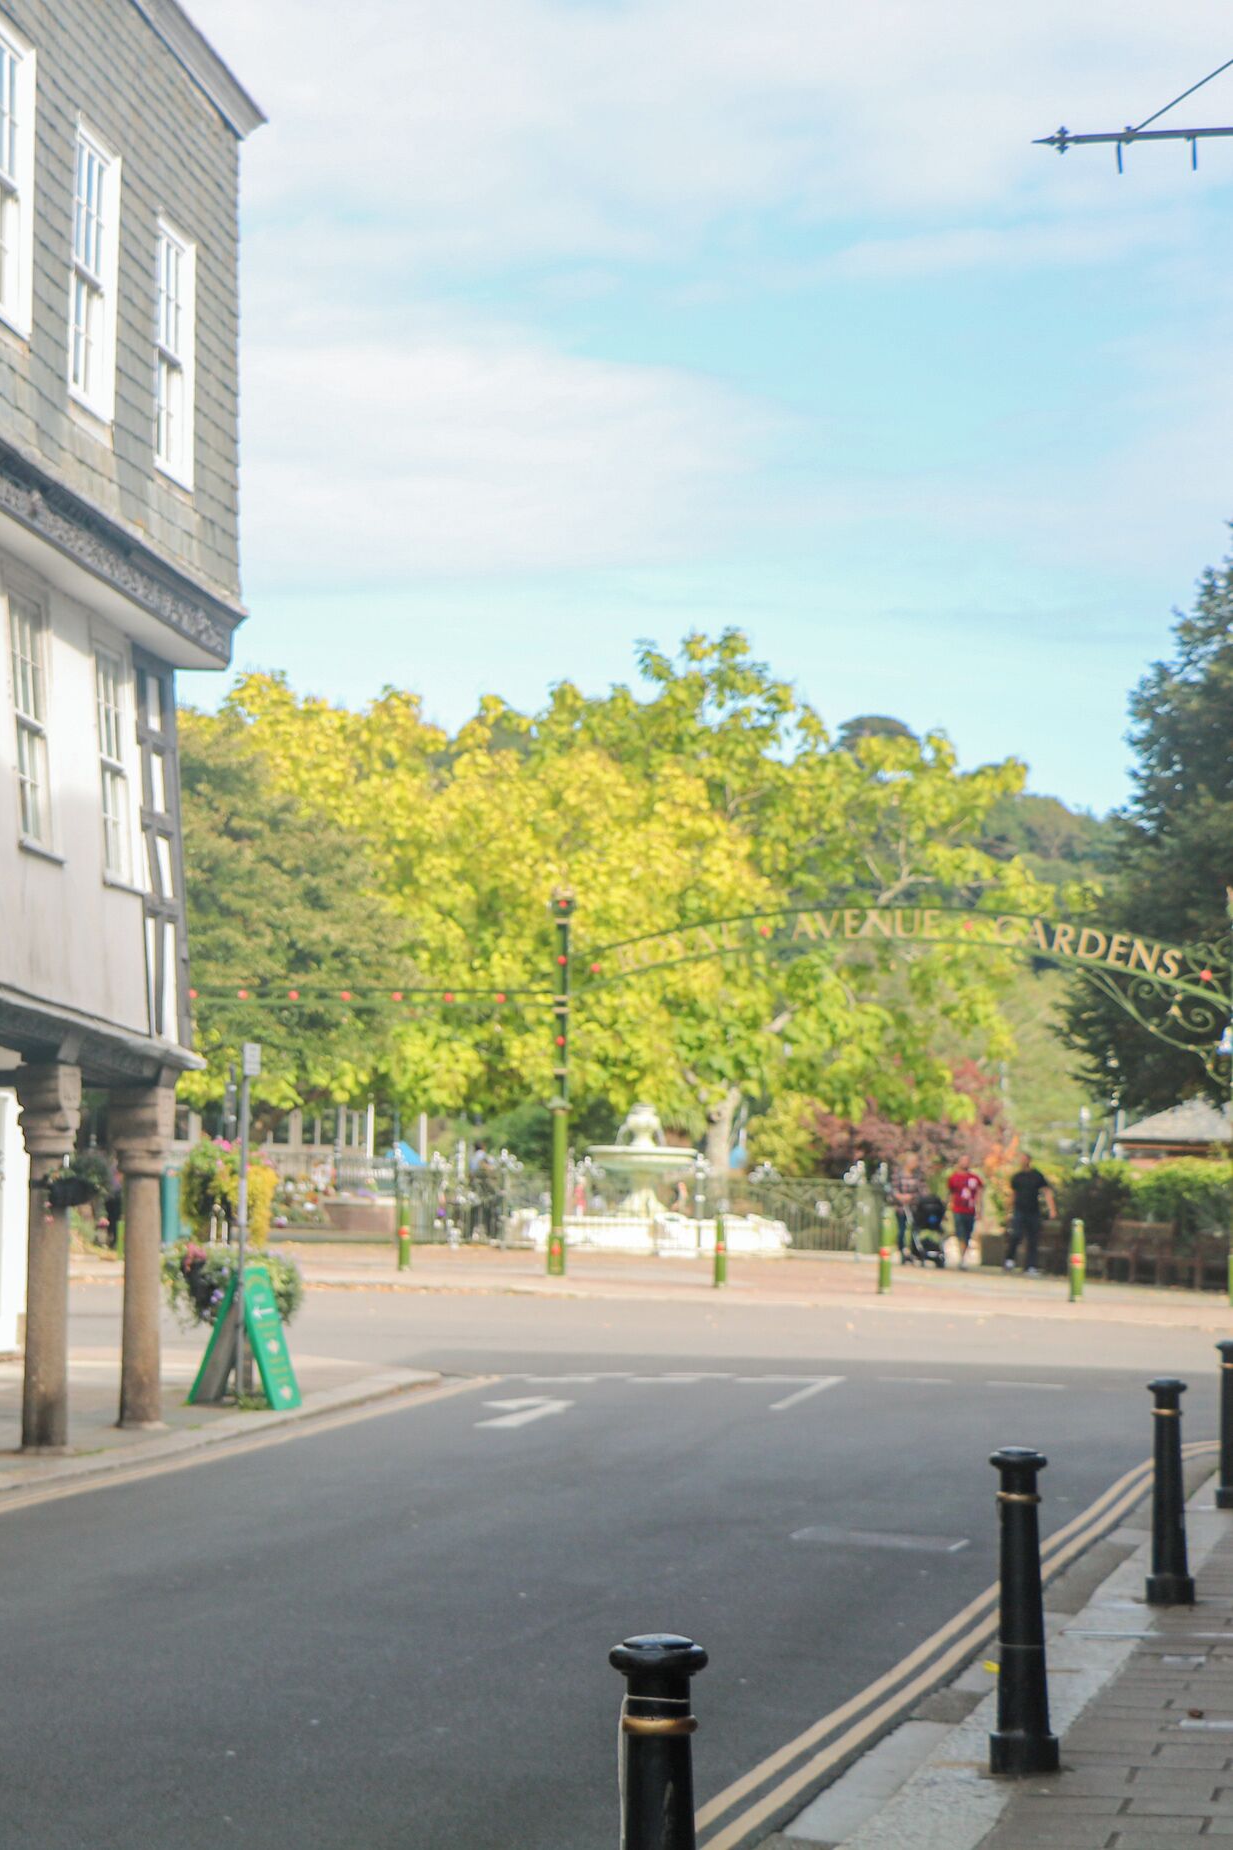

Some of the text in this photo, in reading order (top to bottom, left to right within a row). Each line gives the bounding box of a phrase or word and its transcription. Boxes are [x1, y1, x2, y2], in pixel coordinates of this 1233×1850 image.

[615, 908, 1183, 980] ROYAL AVENUE GARDENS
